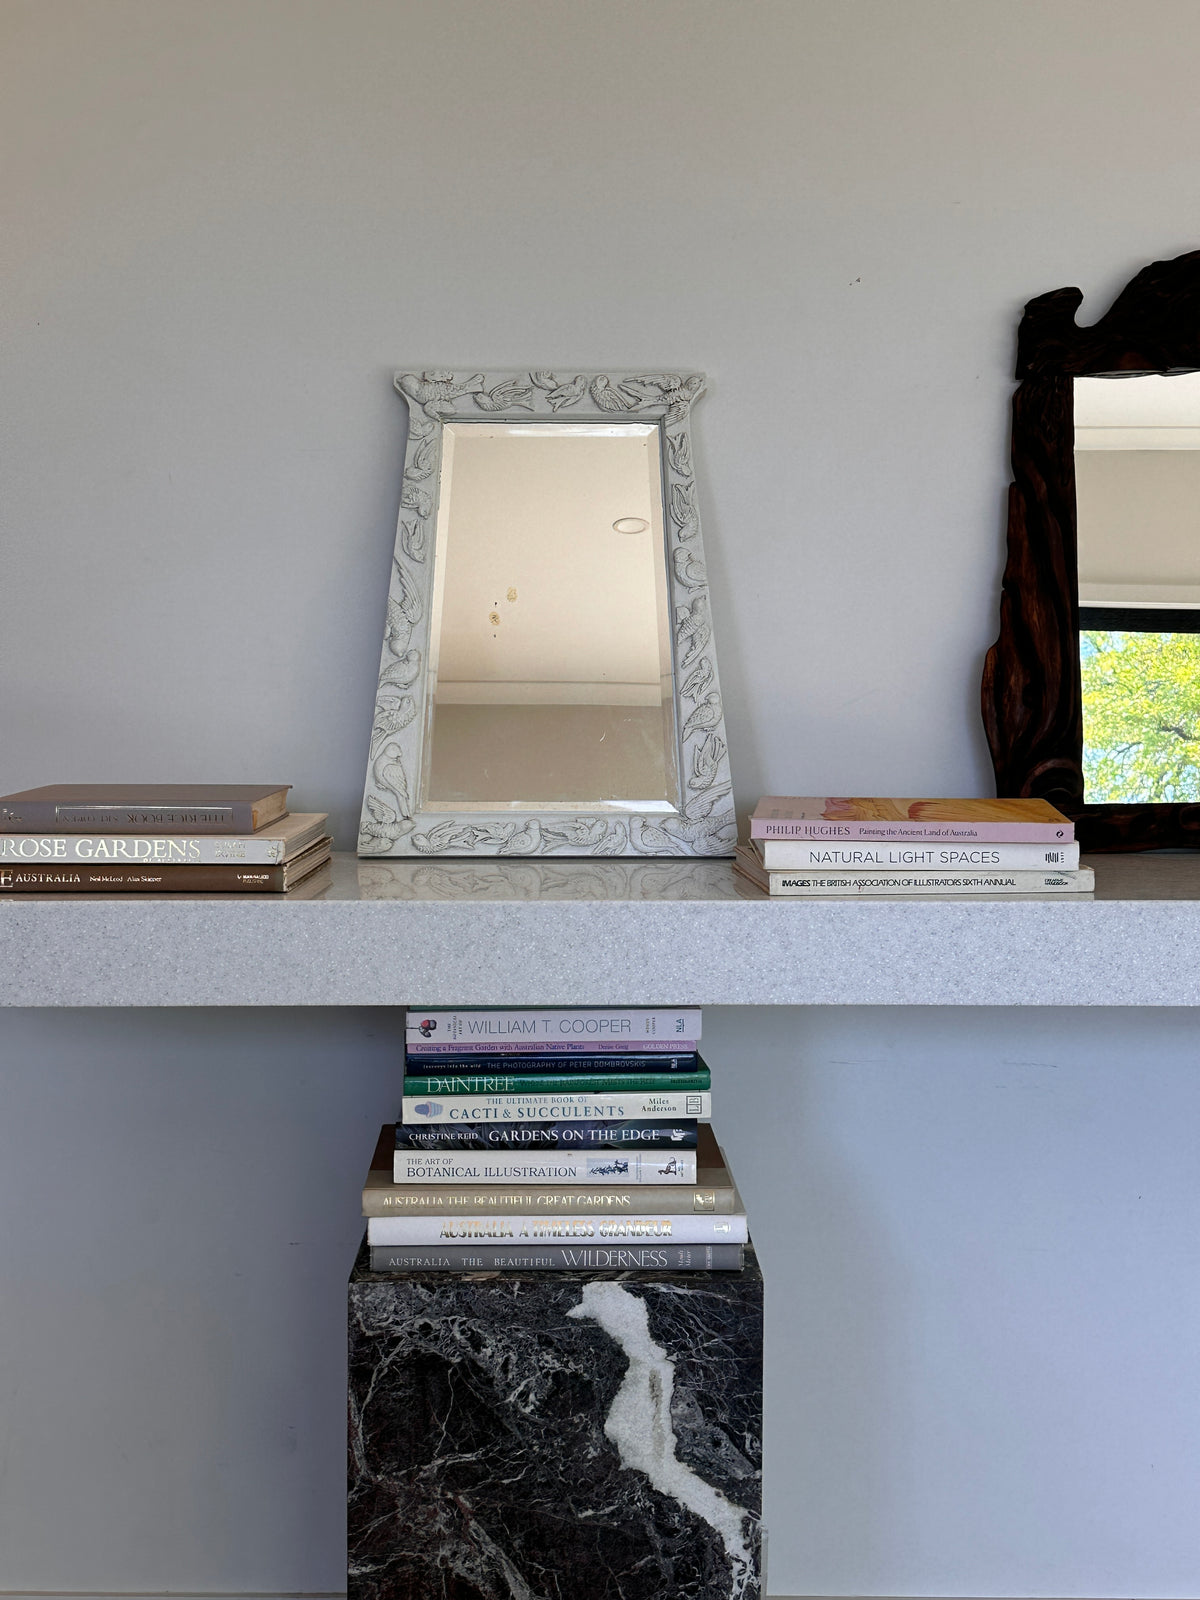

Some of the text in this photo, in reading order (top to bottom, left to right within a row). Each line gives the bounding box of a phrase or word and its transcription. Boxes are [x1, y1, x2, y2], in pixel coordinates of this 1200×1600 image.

[128, 813, 163, 825] BOOK
[766, 825, 978, 837] PHILIP HUGHES Painting the Ancient Land of Australia
[0, 838, 67, 858] ROSE
[75, 838, 200, 858] GARDENS
[809, 851, 1000, 864] NATURAL LIGHT SPACES
[16, 873, 81, 883] AUSTRALIA
[782, 879, 811, 887] IMAGES
[812, 879, 826, 887] THE
[827, 879, 851, 887] BRITISH
[852, 879, 900, 887] ASSOCIATION
[902, 879, 913, 887] OF
[914, 879, 962, 887] ILLUSTRATORS
[984, 878, 1016, 886] ANNUAL
[468, 1019, 631, 1034] WILLIAM T. COOPER
[676, 1018, 684, 1033] NLA
[503, 1061, 555, 1069] PHOTOGRAPHY
[594, 1060, 646, 1068] DOMBROVSKIS
[427, 1076, 515, 1093] DAINTREE
[449, 1106, 624, 1119] CACTI & SUCCULENTS
[409, 1129, 660, 1142] CHRISTINE REID GARDENS ON THE EDGE
[407, 1167, 577, 1177] BOTANICAL ILLUSTRATION
[383, 1195, 631, 1207] AUSTRALIA THE BEAUTIFUL GREAT GARDENS
[440, 1220, 673, 1238] AUSTRALIA A TIMELESS GRANDEUR
[389, 1257, 450, 1266] AUSTRALIA
[461, 1257, 483, 1266] THE
[494, 1257, 556, 1266] BEAUTIFUL
[561, 1249, 668, 1267] WILDERNESS
